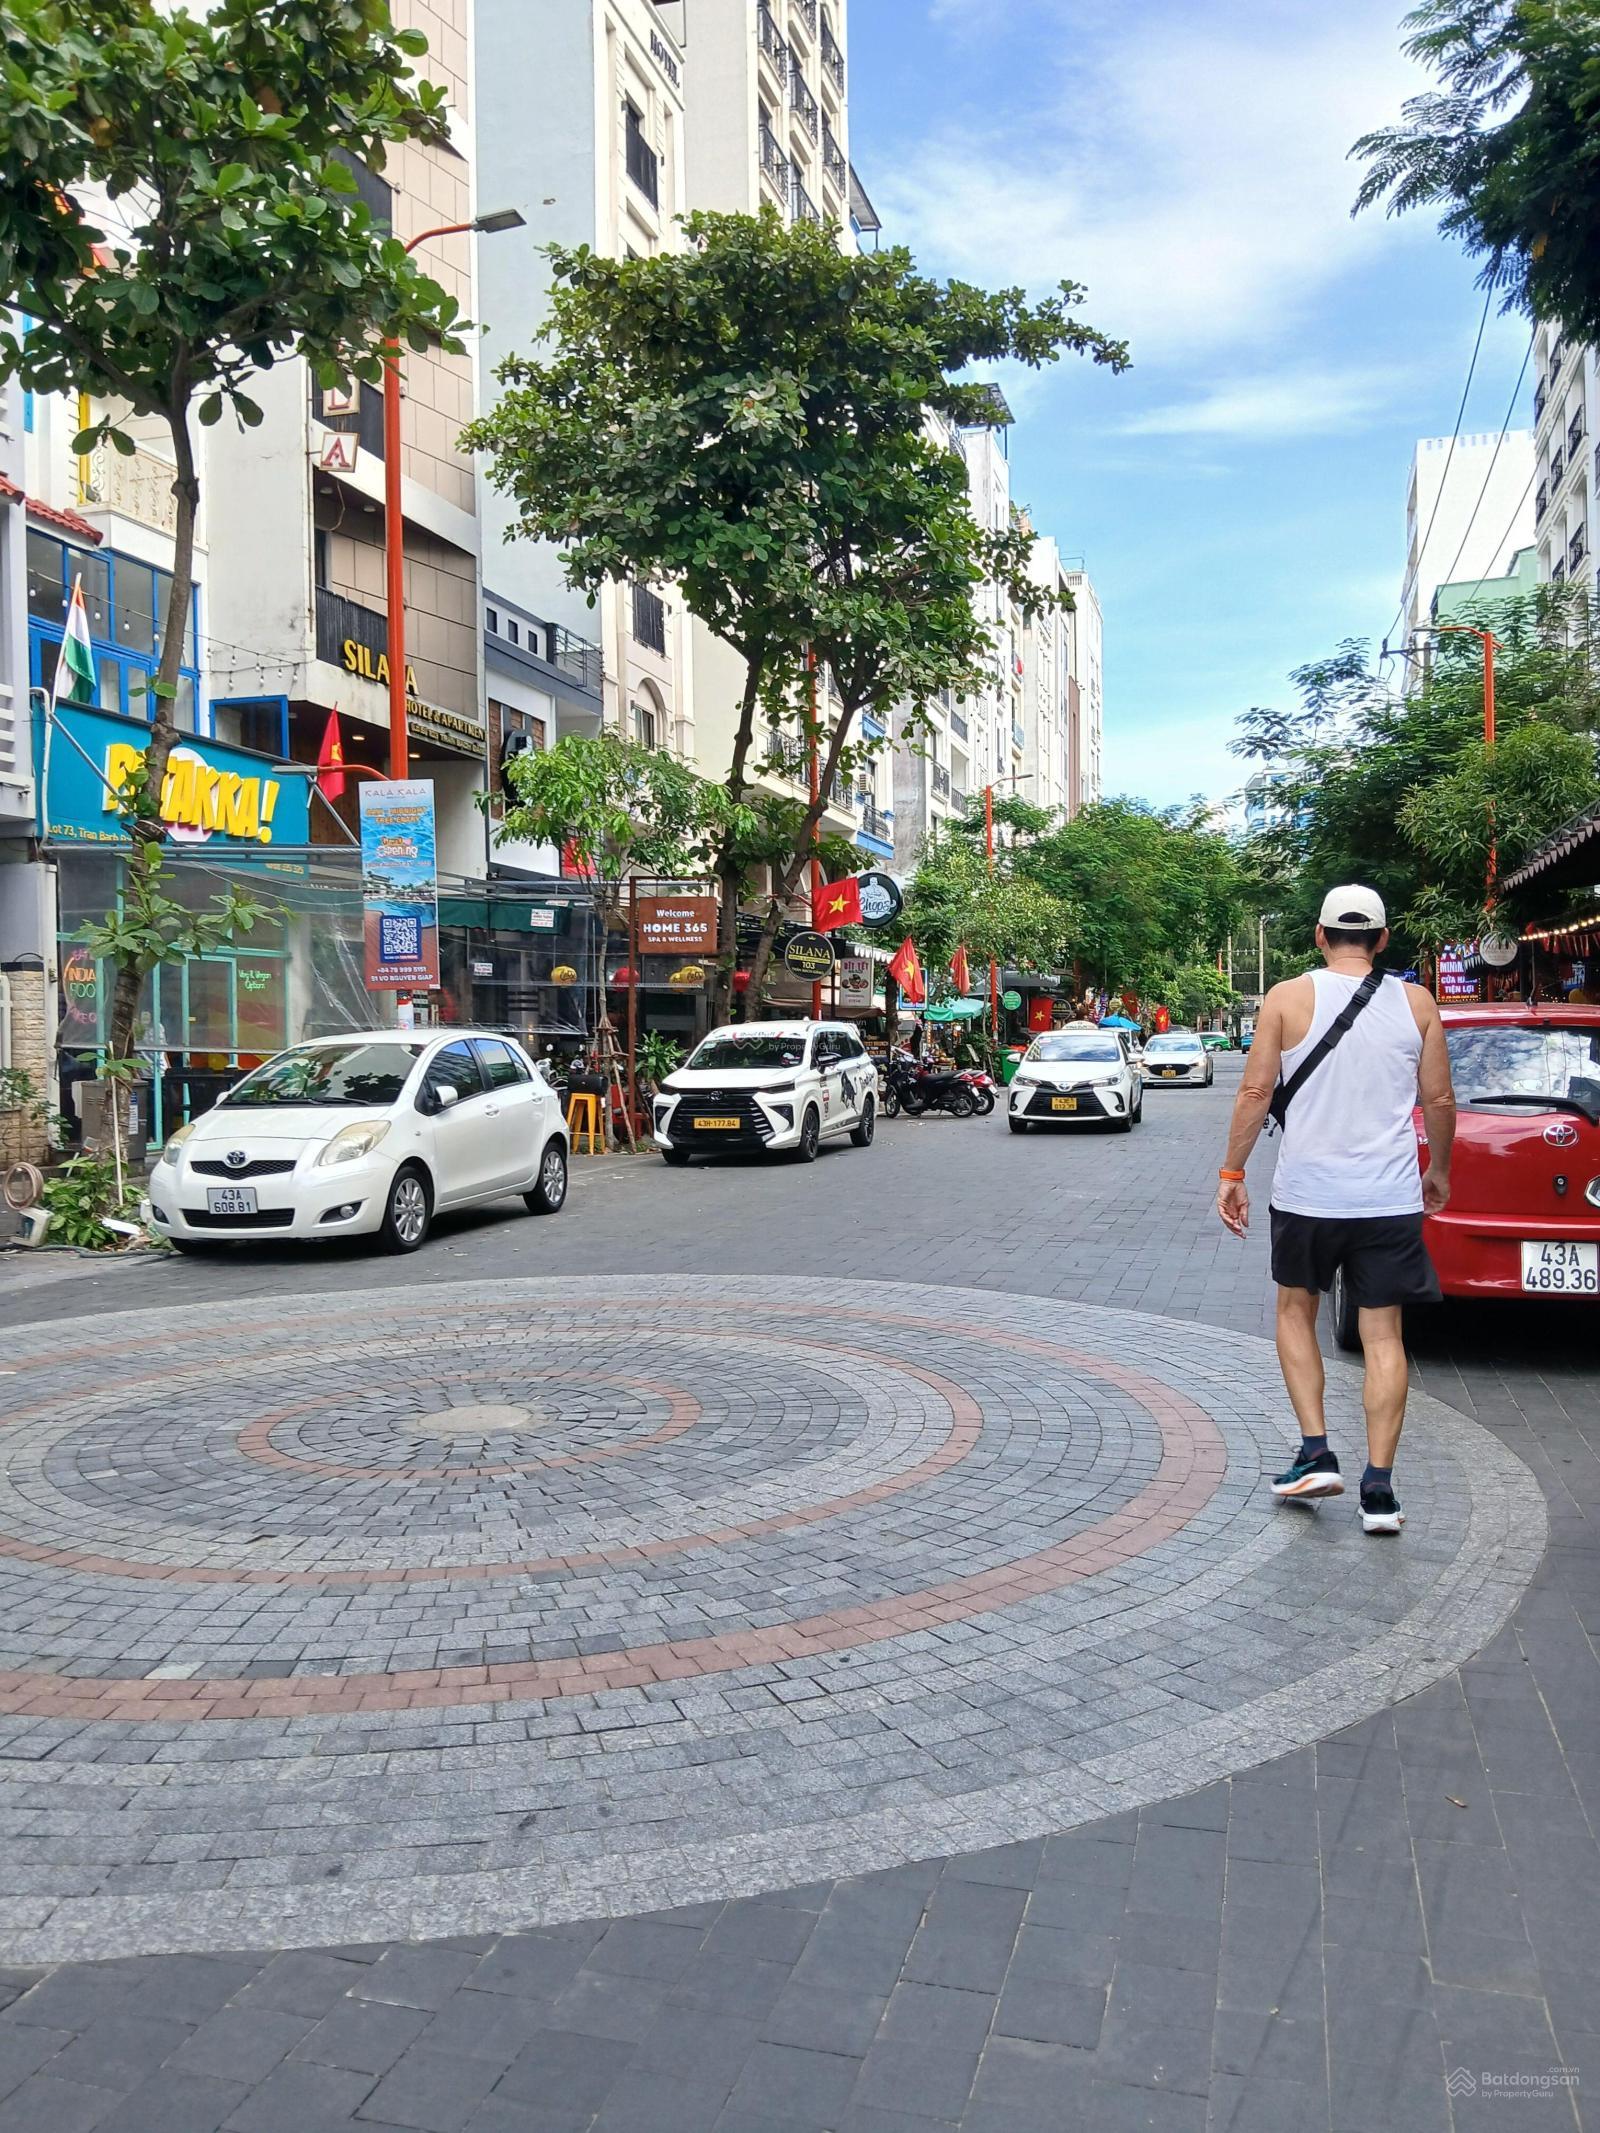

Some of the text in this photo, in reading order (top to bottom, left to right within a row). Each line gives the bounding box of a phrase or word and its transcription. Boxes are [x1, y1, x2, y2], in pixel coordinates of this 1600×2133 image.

[343, 640, 419, 696] SILAA
[406, 701, 433, 721] HOTEL
[365, 788, 427, 797] KALA KALA
[656, 909, 695, 918] Welcome
[643, 923, 708, 933] HOME 365
[789, 944, 831, 959] SILANA
[802, 961, 816, 969] 103
[221, 1189, 242, 1201] 43A
[214, 1201, 250, 1214] 608.81
[1540, 1244, 1580, 1267] 43A
[1525, 1266, 1596, 1291] 489.36
